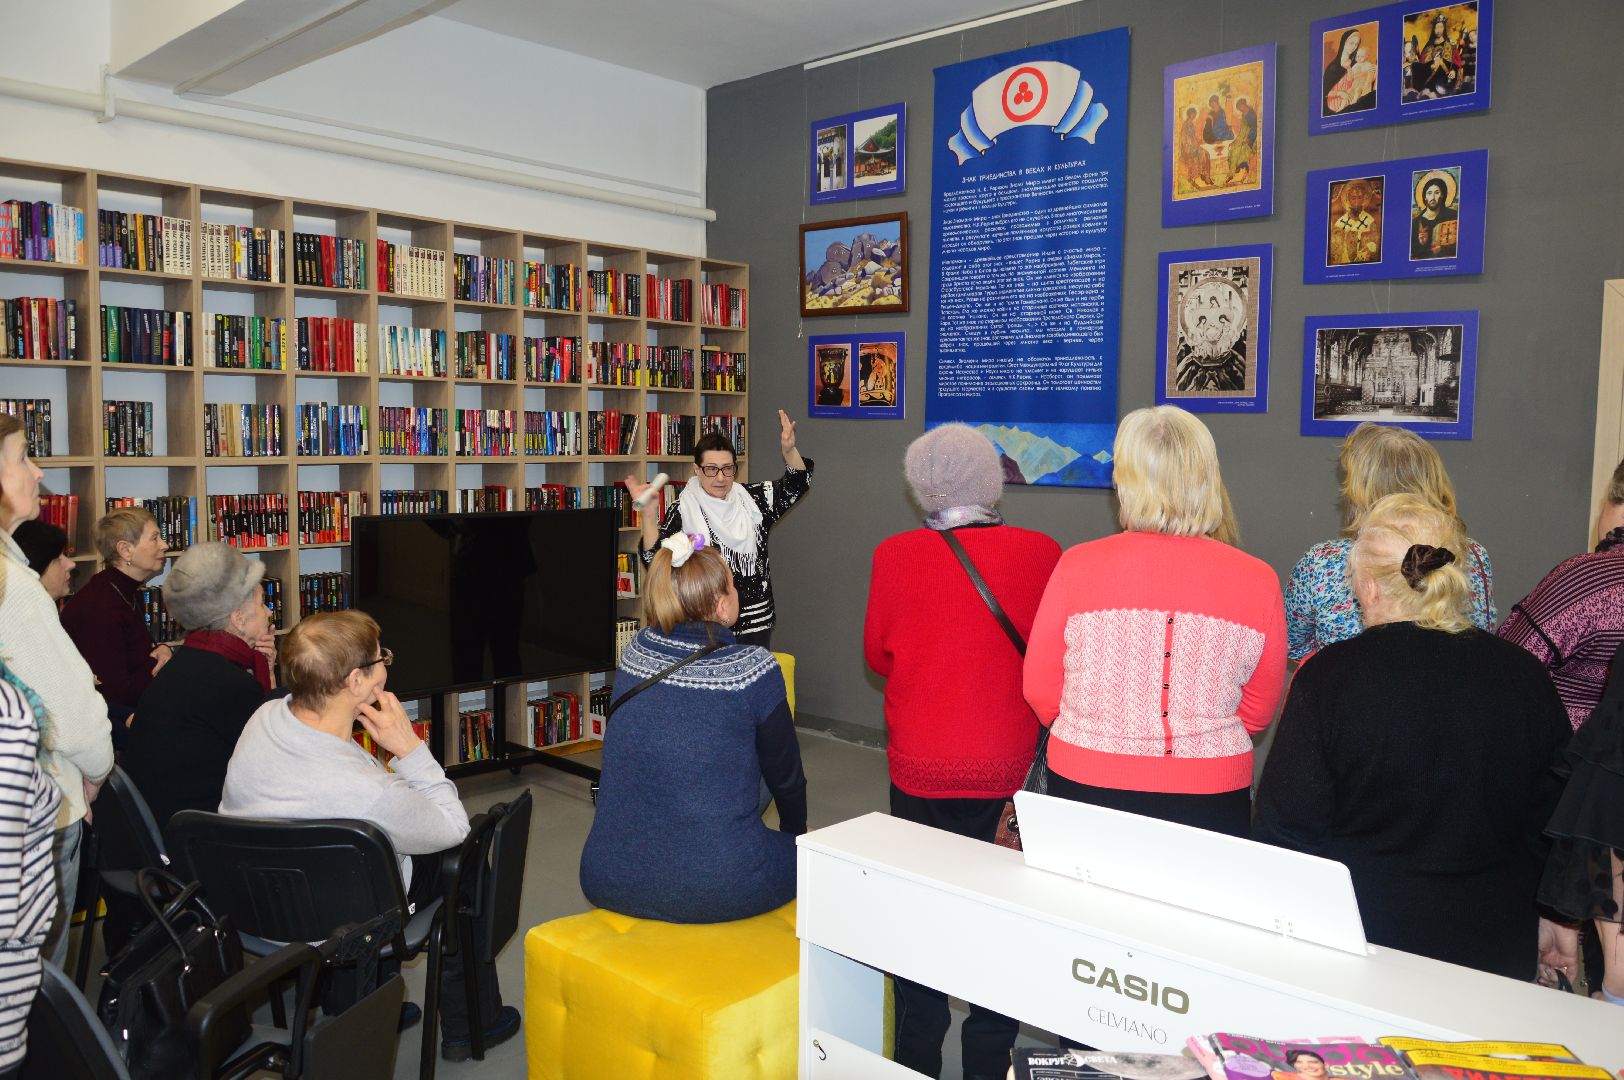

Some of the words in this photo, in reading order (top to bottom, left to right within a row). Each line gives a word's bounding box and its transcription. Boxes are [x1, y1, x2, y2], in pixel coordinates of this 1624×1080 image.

[1025, 166, 1044, 174] ВЕКАХ
[1072, 958, 1189, 1014] CASIO
[1087, 1006, 1167, 1044] CELVIANO
[1028, 1057, 1065, 1066] ВОКРУГ
[1084, 1055, 1118, 1065] СВЕТА
[1330, 1061, 1404, 1079] style
